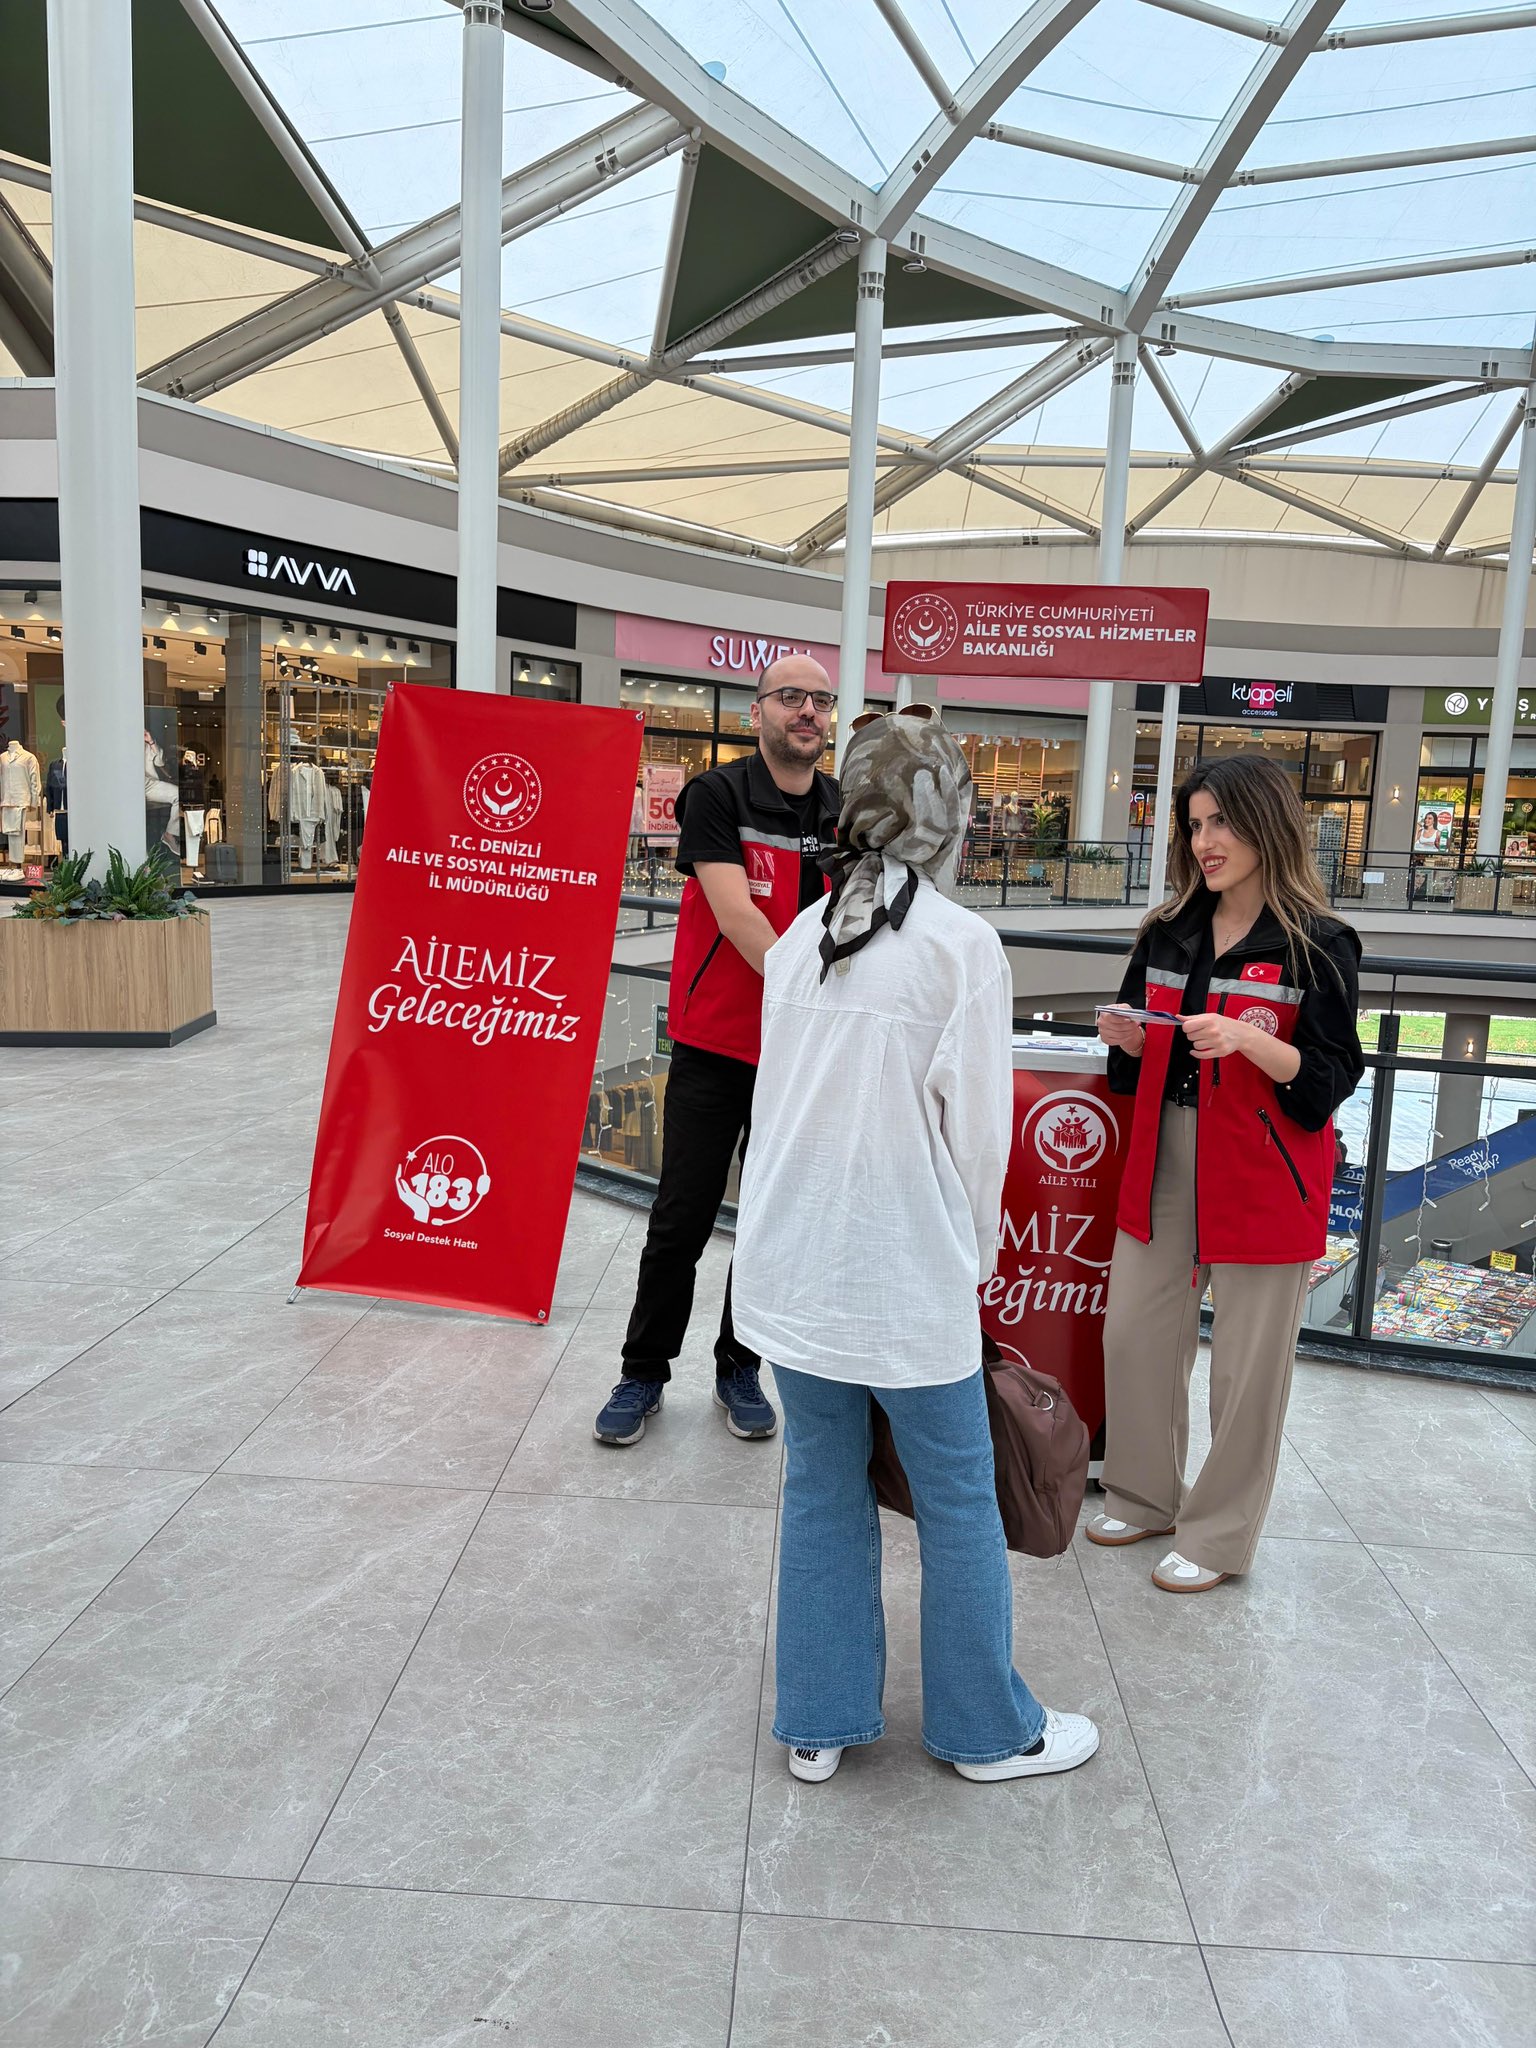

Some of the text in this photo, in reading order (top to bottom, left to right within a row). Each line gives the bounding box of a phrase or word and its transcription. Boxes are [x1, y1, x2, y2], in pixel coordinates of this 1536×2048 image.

[270, 555, 357, 595] AVVA
[966, 601, 1155, 622] TÜRKİYE CUMHURİYETİ
[964, 620, 1197, 643] AİLE VE SOSYAL HİZMETLER
[710, 635, 811, 671] SUW
[962, 638, 1054, 658] BAKANLIĞI
[1242, 709, 1278, 717] accessories
[449, 834, 542, 859] T.C. DENİZLİ
[386, 846, 598, 886] AİLE VE SOSYAL HİZMETLER
[428, 871, 550, 902] İL MÜDÜRLÜĞÜ
[391, 935, 568, 1001] AİLEMİZ
[368, 983, 581, 1046] Geleceğimiz
[422, 1152, 455, 1175] ALO
[1448, 1149, 1484, 1170] Ready
[411, 1172, 473, 1211] 183
[1038, 1173, 1097, 1188] AİLE YILI
[384, 1228, 478, 1249] Sosyal Destek Hattı
[795, 1748, 820, 1762] NIKE
